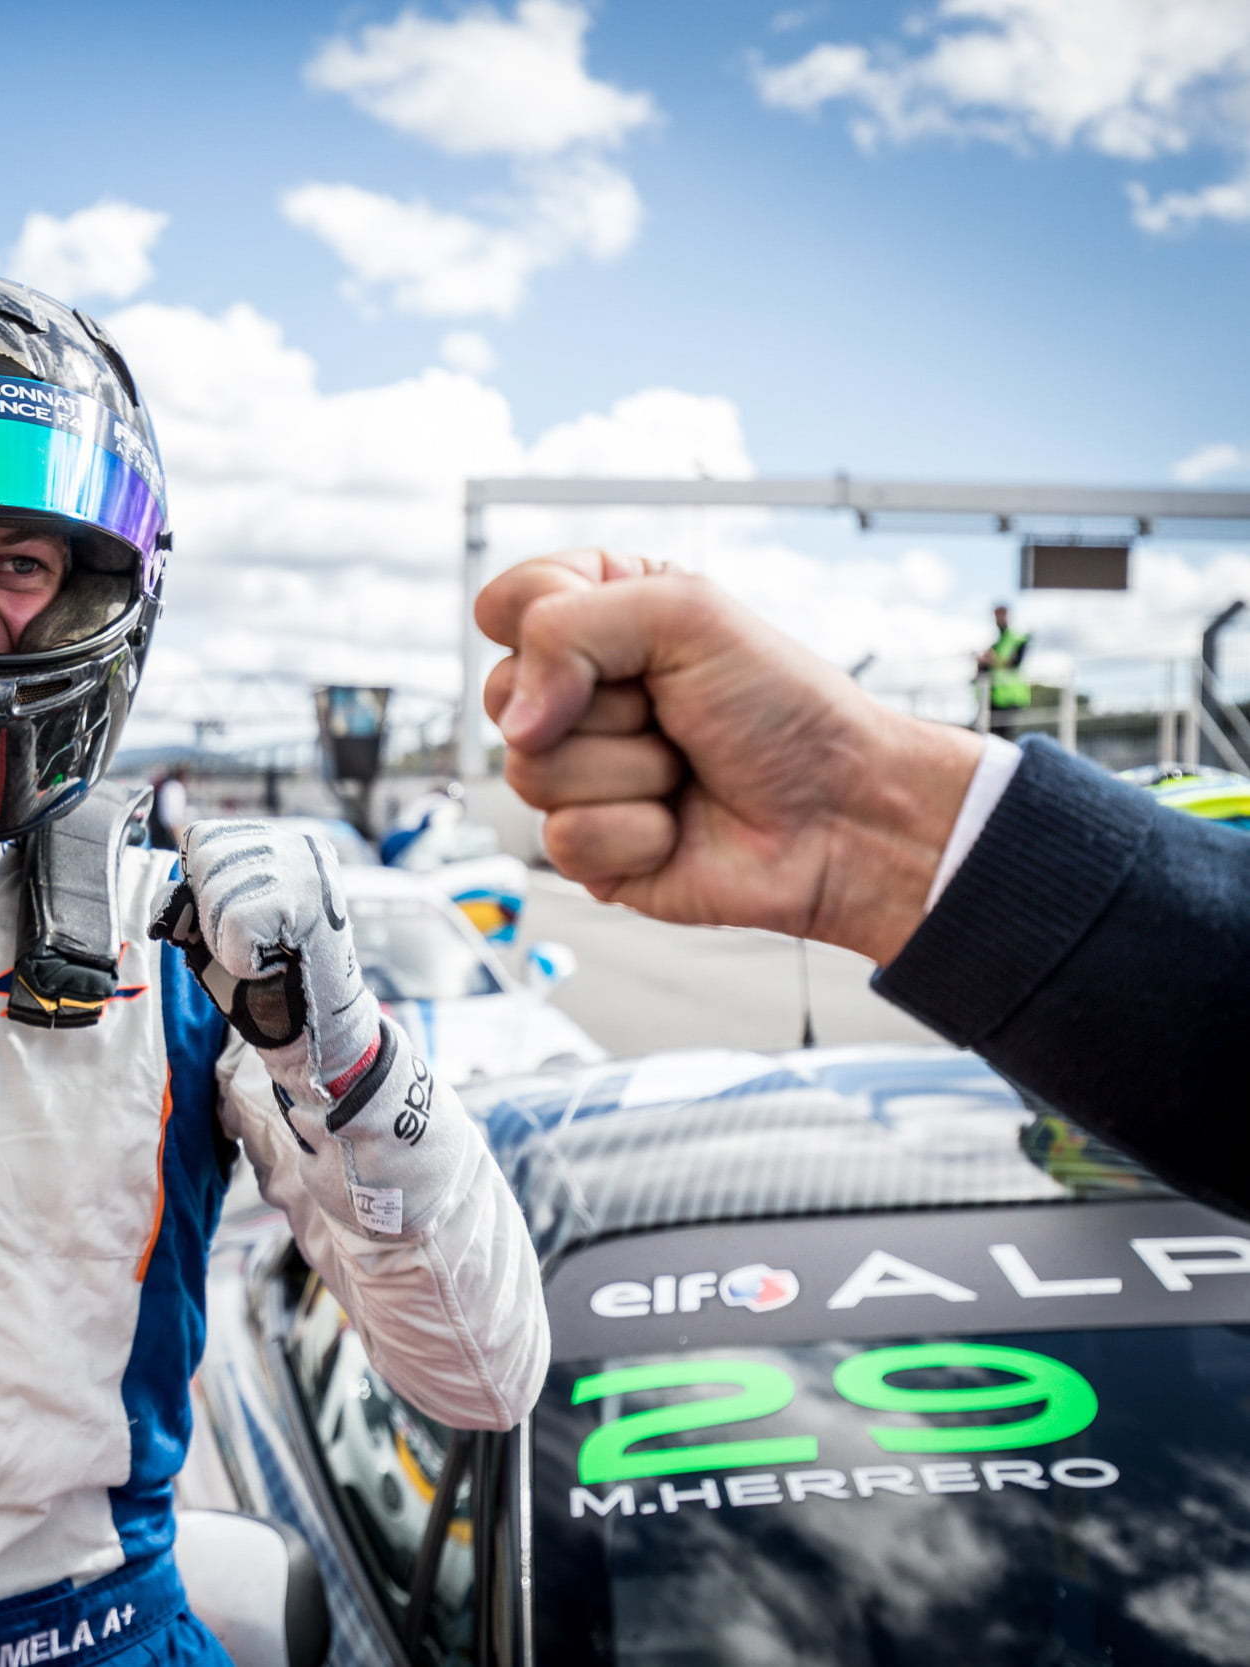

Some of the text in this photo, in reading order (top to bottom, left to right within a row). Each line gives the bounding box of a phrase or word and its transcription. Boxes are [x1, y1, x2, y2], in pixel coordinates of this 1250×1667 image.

[590, 1272, 718, 1318] elf
[571, 1342, 1099, 1485] 29
[569, 1457, 1120, 1518] M.HERRERO
[0, 1619, 96, 1667] MELA
[102, 1602, 137, 1639] A+
